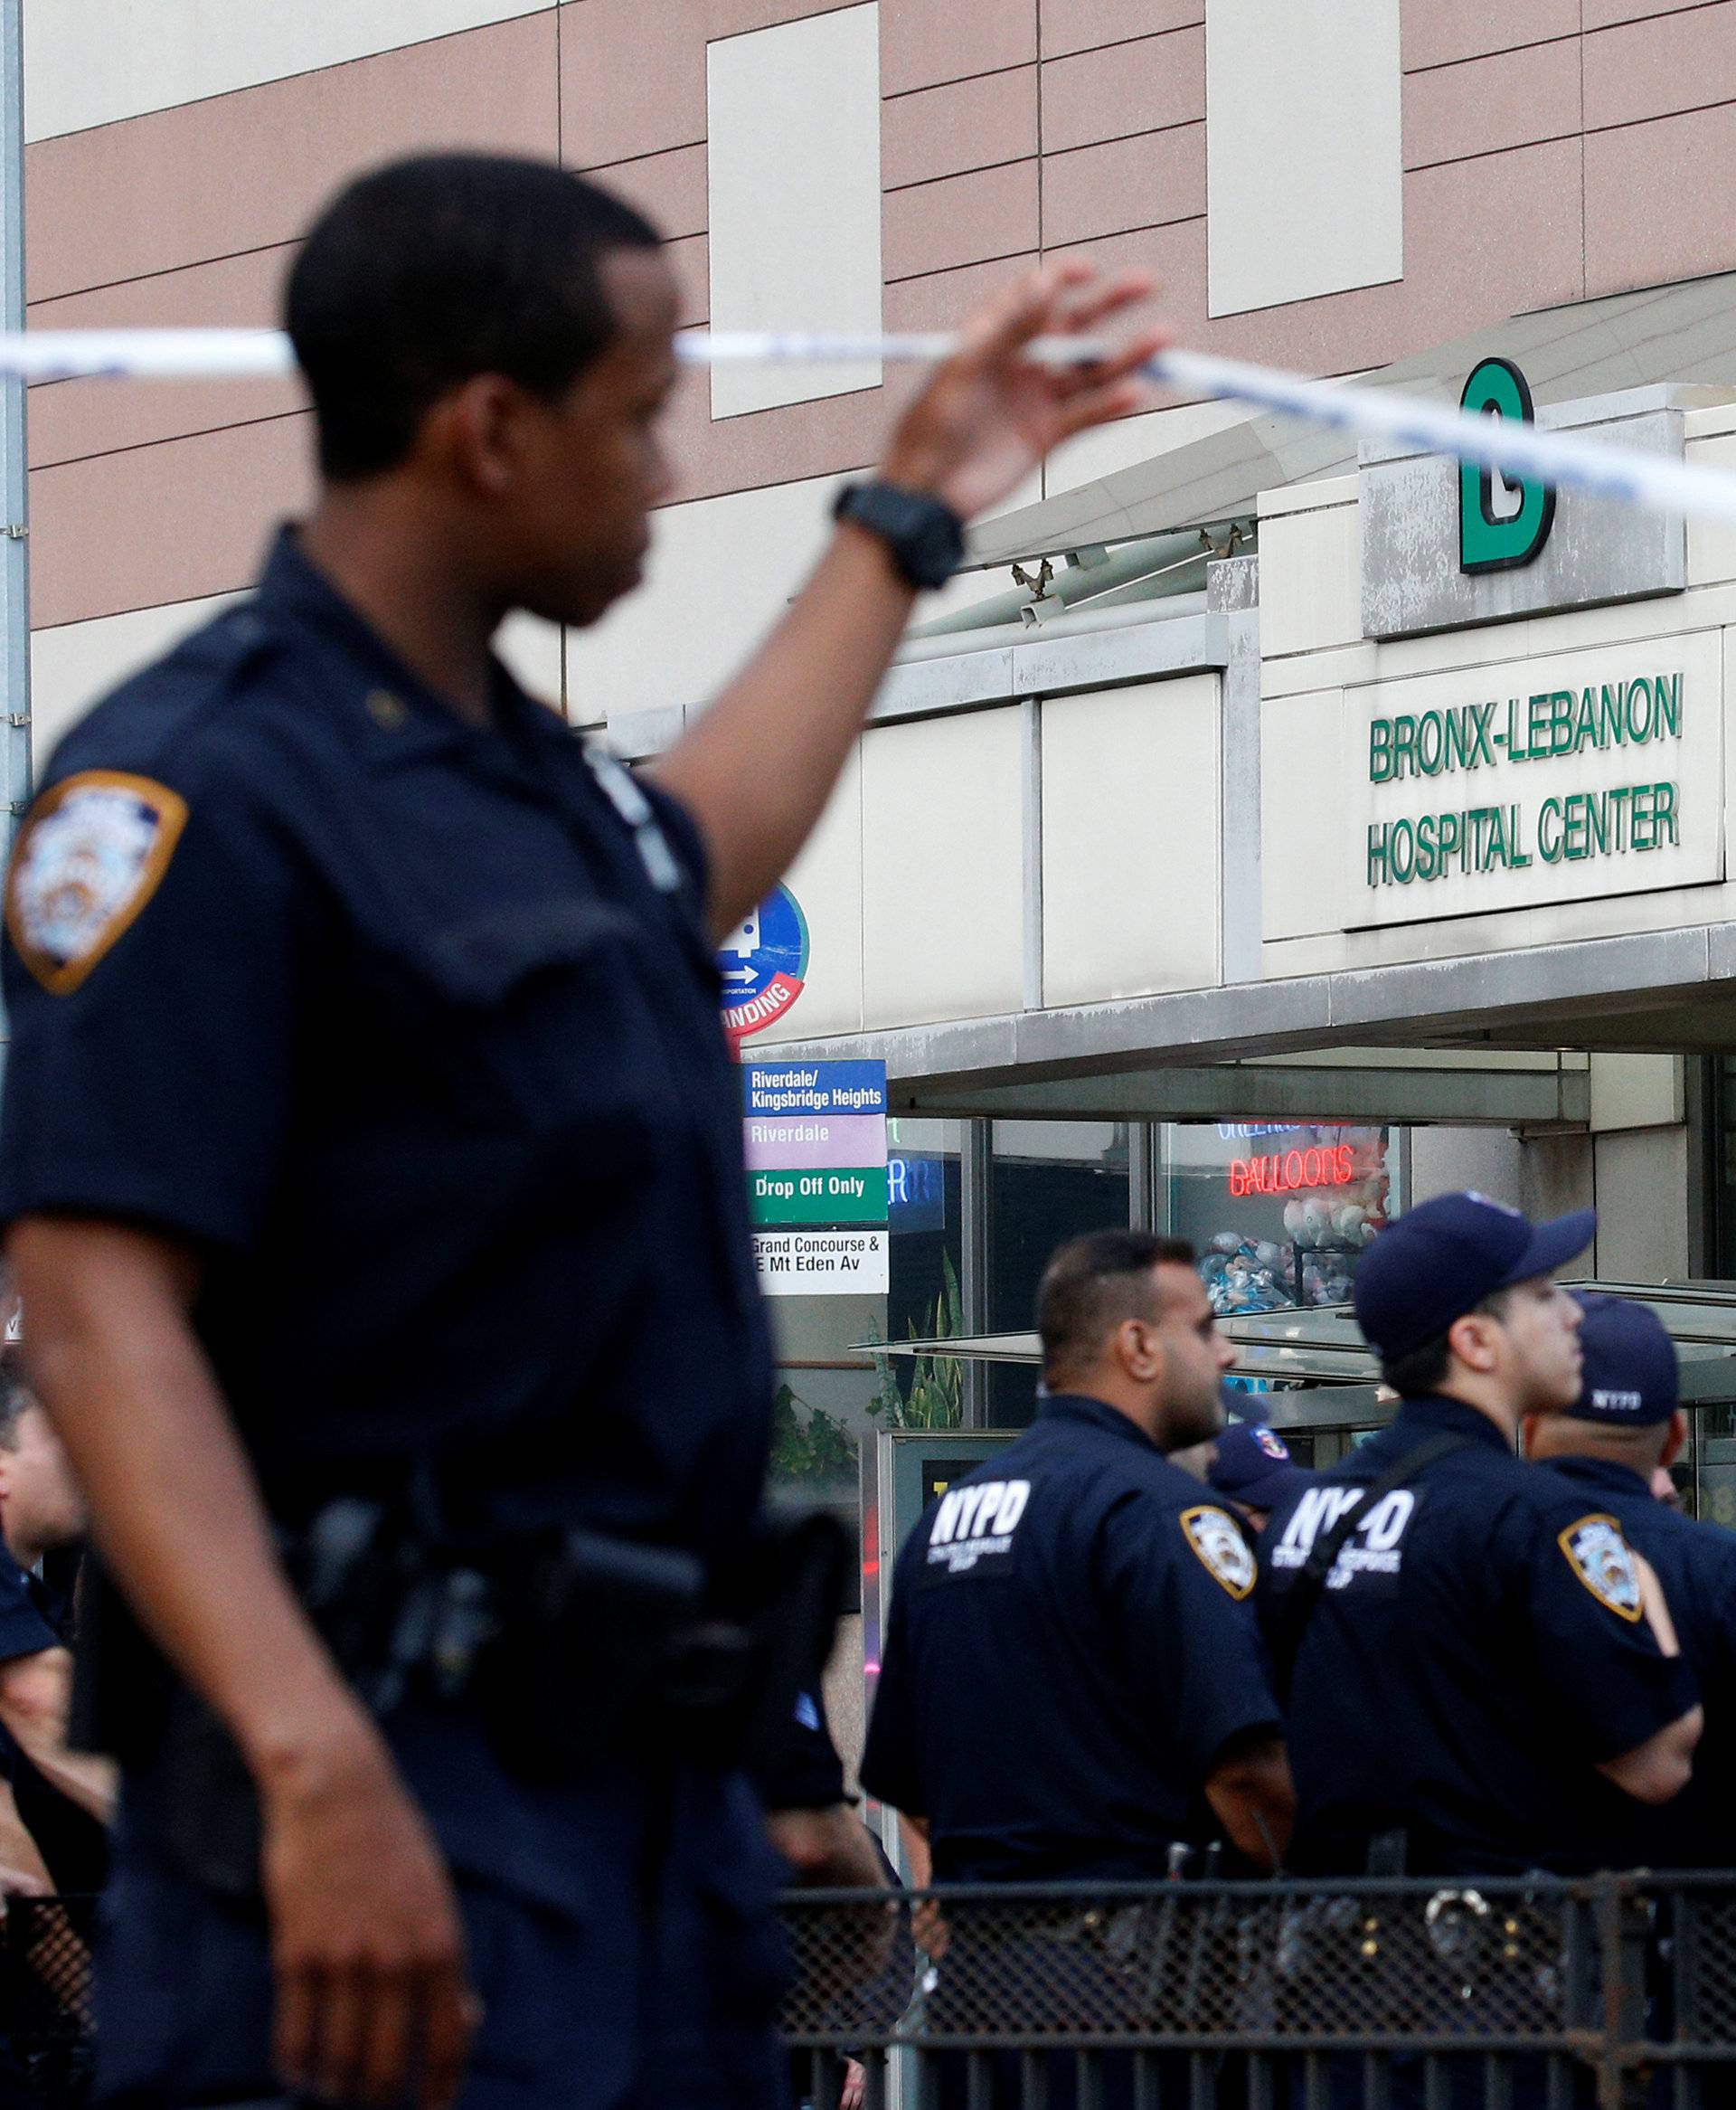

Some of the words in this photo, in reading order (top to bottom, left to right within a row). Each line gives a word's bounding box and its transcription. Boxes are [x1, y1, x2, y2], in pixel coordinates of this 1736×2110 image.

[1369, 673, 1684, 783] BRONX-LEBANON
[1367, 804, 1533, 888] HOSPITAL
[1538, 781, 1681, 864] CENTER
[721, 983, 791, 1028] ANDING
[751, 1069, 818, 1088] Riverdale/
[751, 1090, 829, 1111] Kingsbridge
[833, 1088, 882, 1109] Heights
[751, 1124, 829, 1143] Riverdale
[1231, 1144, 1354, 1197] BALLOONS
[756, 1178, 794, 1199] Drop
[799, 1178, 823, 1196] Off
[828, 1176, 864, 1197] Only
[752, 1236, 790, 1254] Grand
[795, 1235, 865, 1253] Concourse
[869, 1235, 880, 1252] &
[756, 1256, 765, 1272] E
[770, 1256, 790, 1272] Mt
[796, 1255, 835, 1271] Eden
[840, 1254, 860, 1270] Av
[929, 1480, 1032, 1545] NYPD
